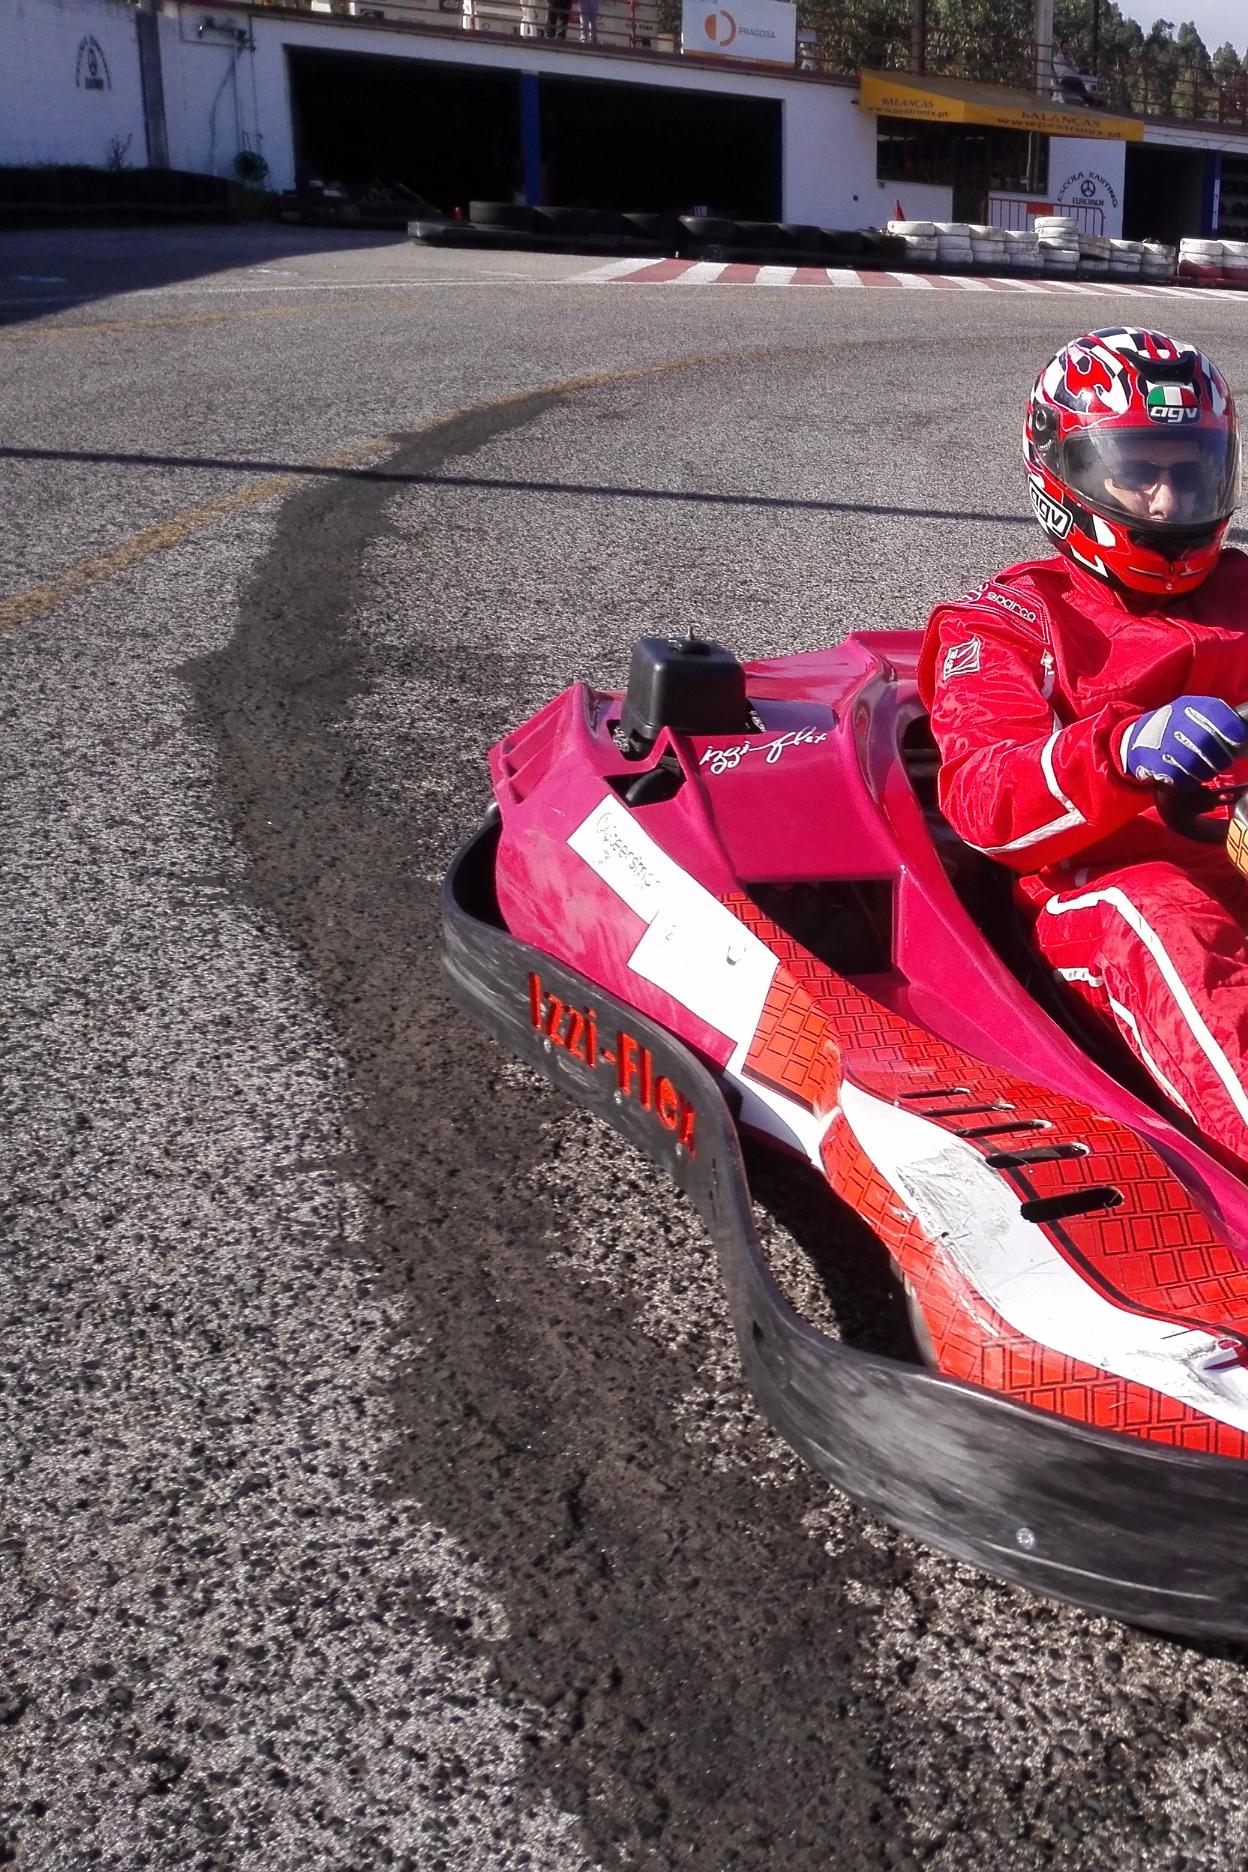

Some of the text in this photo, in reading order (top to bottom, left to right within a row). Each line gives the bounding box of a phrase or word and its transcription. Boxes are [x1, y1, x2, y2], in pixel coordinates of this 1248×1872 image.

[738, 26, 776, 39] PRAGOSA
[1057, 171, 1119, 209] ESCOLA KARTING
[1150, 406, 1199, 423] agv
